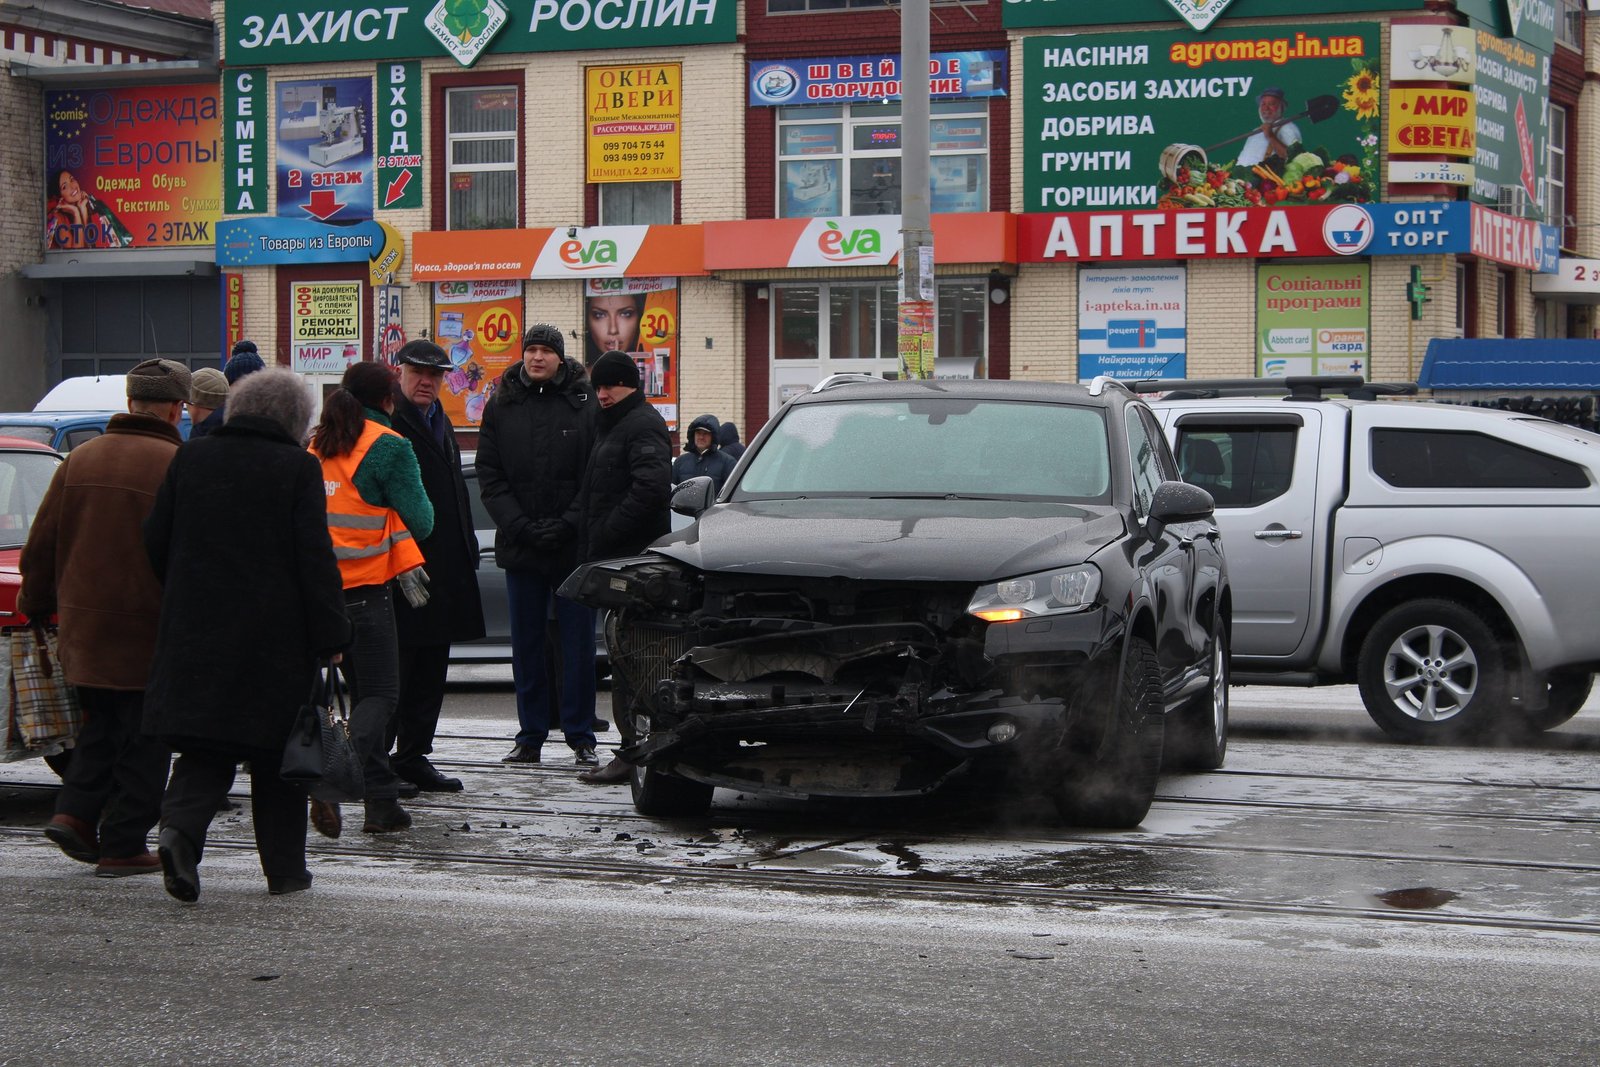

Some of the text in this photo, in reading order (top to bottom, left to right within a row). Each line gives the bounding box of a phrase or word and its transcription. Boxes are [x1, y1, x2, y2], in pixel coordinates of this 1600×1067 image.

[529, 0, 716, 33] РОСЛИН
[239, 7, 409, 48] ЗАХИСТ
[430, 22, 458, 51] ЗАХИСТ
[474, 16, 502, 50] РОСЛИН
[1043, 45, 1149, 68] НАСІННЯ
[1170, 33, 1364, 68] agromag.in.ua
[600, 68, 669, 89] ОКНА
[808, 58, 961, 80] ШВЕЙОЕ
[1042, 76, 1253, 103] ЗАСОБИ ЗАХИСТУ
[1504, 66, 1538, 95] ЗАХИСТУ
[89, 92, 218, 128] Одежда
[390, 64, 409, 154] ВХОД
[594, 89, 674, 114] ДВЕРИ
[1413, 95, 1468, 117] МИР
[55, 108, 84, 121] comis
[621, 113, 680, 121] Межкомнатные
[1041, 115, 1156, 141] ДОБРИВА
[1397, 125, 1472, 149] СВЕТА
[236, 73, 255, 211] СЕМЕНА
[603, 140, 665, 151] 099 704 75 44
[49, 135, 218, 173] из Европы
[378, 155, 421, 168] 2 ЭТАЖ
[603, 152, 664, 162] 093 499 09 37
[1041, 151, 1131, 172] ГРУНТИ
[288, 169, 363, 187] 2 этаж
[1440, 164, 1449, 172] 2
[96, 174, 188, 193] Одежда Обувь
[116, 196, 220, 214] Текстиль Сумки
[1041, 185, 1157, 207] ГОРШИКИ
[1394, 209, 1444, 226] ОПТ
[55, 221, 209, 246] СТОК 2 ЭТАЖ
[260, 234, 372, 253] Товары из Европы
[1043, 210, 1298, 260] АПТЕКА
[1387, 230, 1449, 247] ТОРГ
[1472, 207, 1533, 268] АПТЕКА
[372, 248, 399, 280] 2 этаж
[414, 261, 522, 274] Краса, здоров'я та оселя
[1574, 265, 1586, 281] 2
[1130, 274, 1179, 282] замовлення
[1266, 274, 1362, 292] Соціальні
[296, 286, 312, 316] ФОТО
[321, 287, 358, 295] ДОКУМЕНТЫ
[1085, 299, 1181, 314] i-apteka.in.ua
[1266, 296, 1362, 313] програми
[229, 277, 240, 356] СВЕТ
[301, 318, 353, 327] РЕМОНТ
[298, 327, 356, 337] ОДЕЖДЫ
[1271, 336, 1309, 345] Abbott card
[299, 347, 332, 360] МИР
[1332, 342, 1363, 352] кард
[1098, 355, 1168, 365] Найкраща ціна
[1116, 368, 1142, 377] якісні
